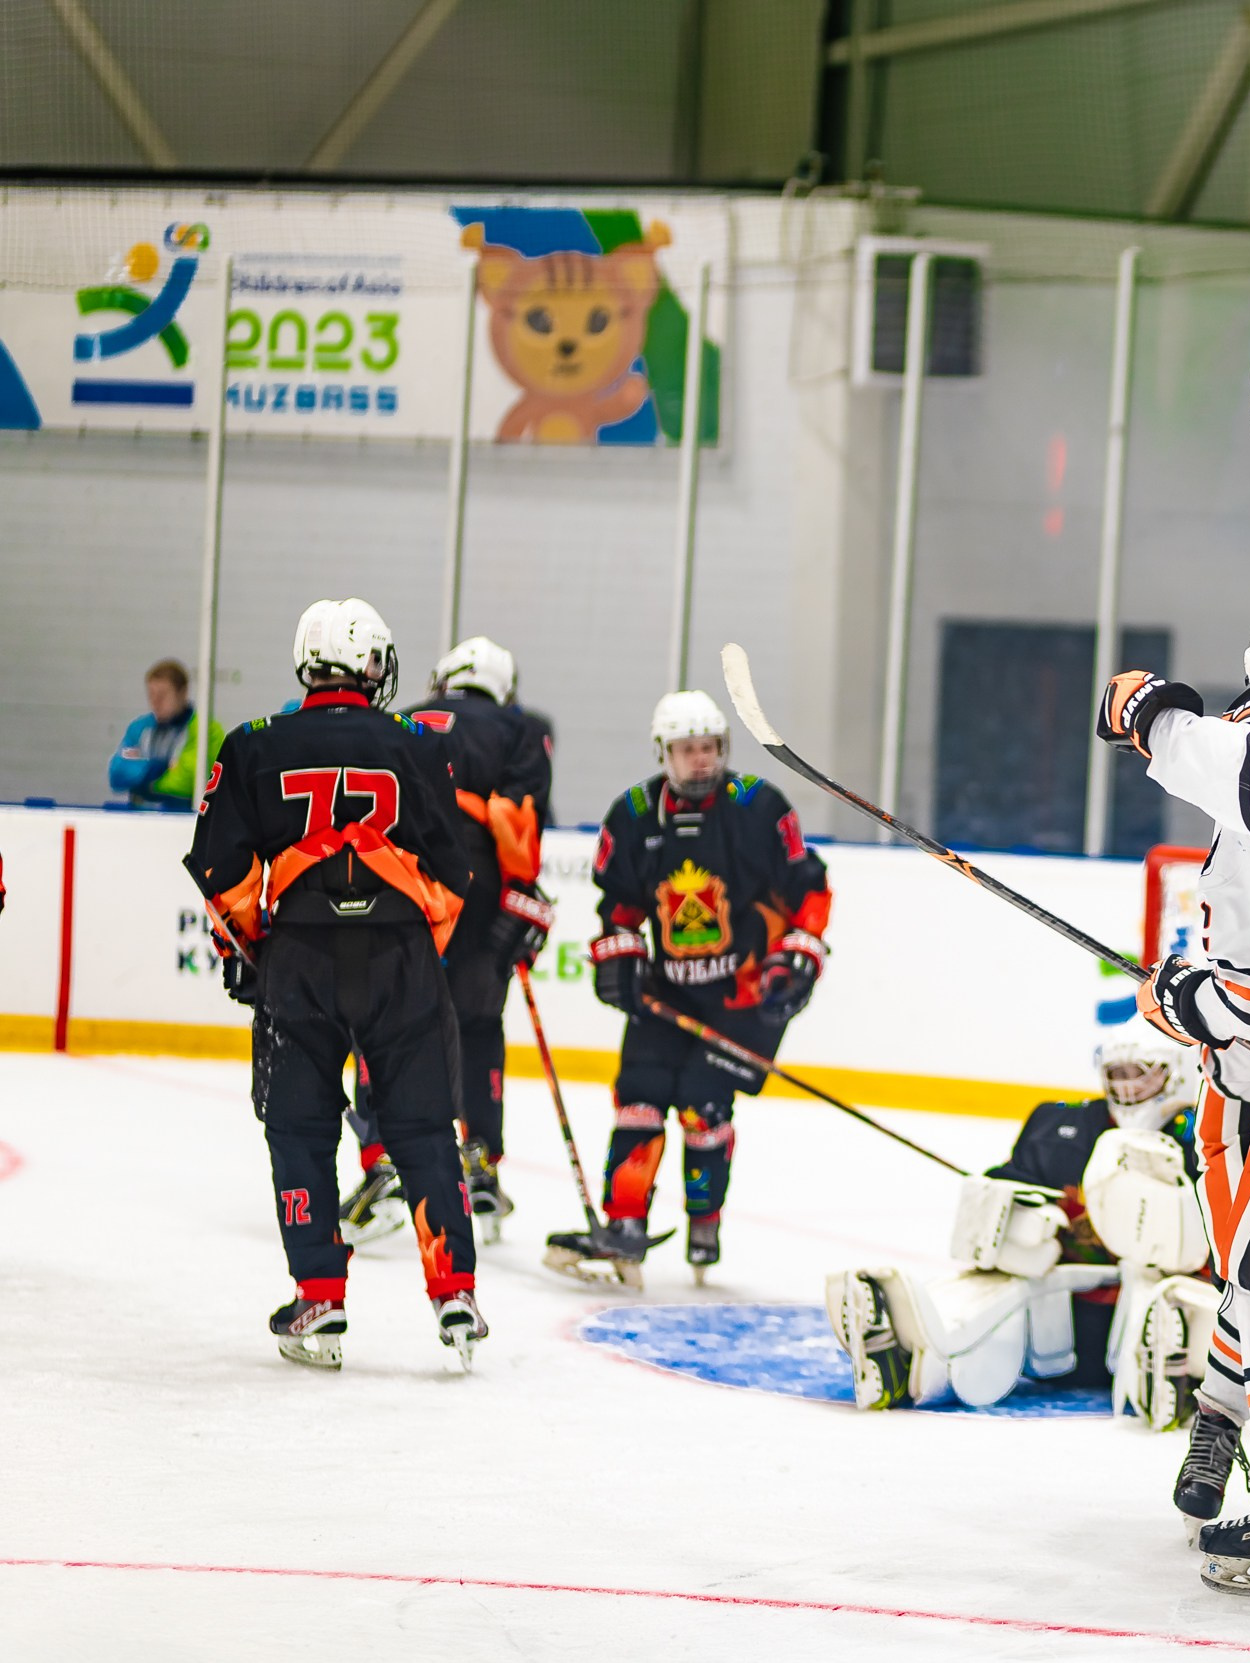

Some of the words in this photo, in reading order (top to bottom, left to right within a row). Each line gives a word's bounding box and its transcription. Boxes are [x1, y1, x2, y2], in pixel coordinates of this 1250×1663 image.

[225, 308, 399, 374] 2023
[281, 1188, 312, 1226] 72
[289, 1299, 333, 1336] CCM
